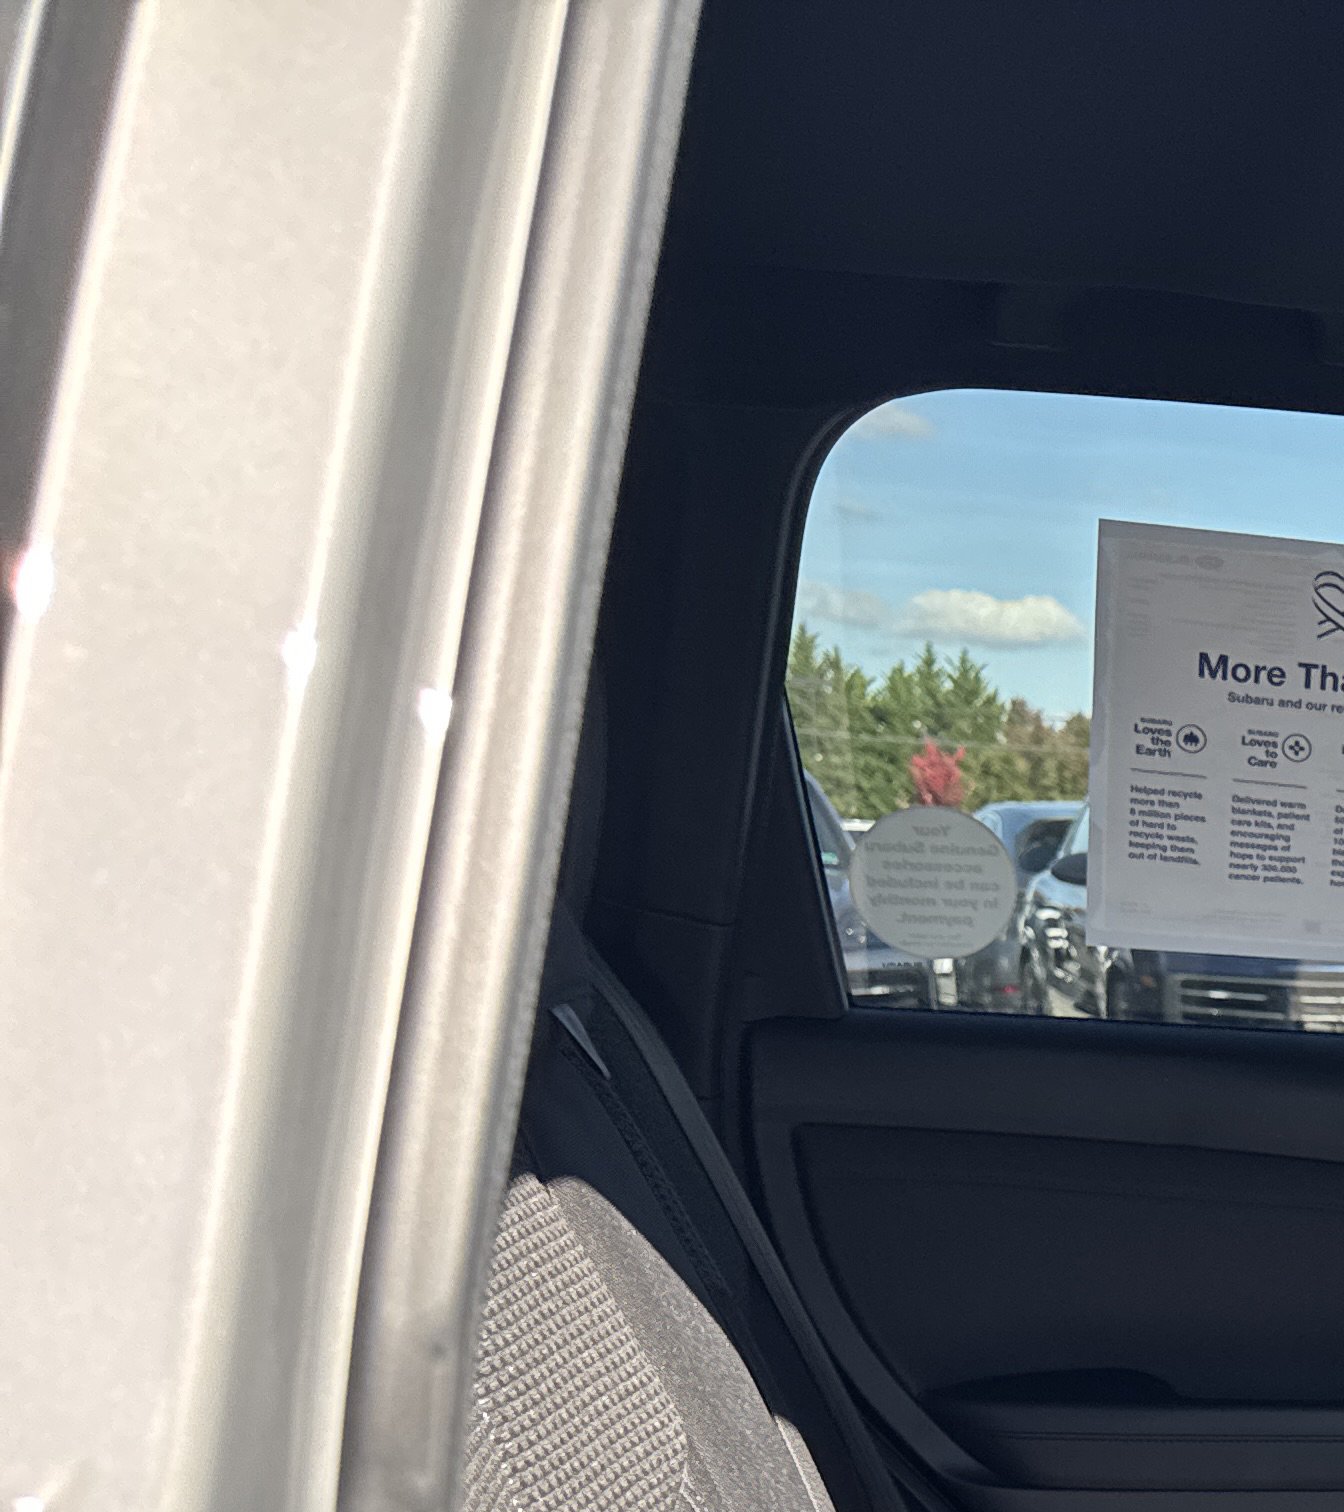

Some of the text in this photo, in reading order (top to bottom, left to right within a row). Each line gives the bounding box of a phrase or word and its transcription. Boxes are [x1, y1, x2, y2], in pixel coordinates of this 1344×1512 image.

[1199, 652, 1286, 686] More
[1228, 691, 1274, 709] Subaru
[1277, 696, 1302, 711] and
[1306, 700, 1326, 713] our
[1134, 724, 1172, 737] Loves
[1151, 736, 1172, 747] the
[1242, 736, 1278, 748] Loves
[1136, 745, 1171, 759] Earth
[1266, 750, 1278, 759] to
[1248, 756, 1277, 769] Care
[1131, 785, 1202, 801] Helped recycle
[1130, 799, 1180, 809] more than
[1232, 795, 1306, 809] Delivered warm
[1138, 809, 1171, 819] million
[1174, 811, 1206, 823] pieces
[1232, 806, 1310, 822] blankets, patient
[1129, 819, 1177, 831] of hard to
[1231, 819, 1294, 831] care kits, and
[1333, 827, 1343, 835] of
[1129, 830, 1164, 842] recycle
[1230, 830, 1290, 843] encouraging
[1129, 841, 1194, 854] keeping them
[1230, 840, 1291, 852] messages of
[1129, 852, 1144, 860] out
[1147, 852, 1157, 861] of
[1230, 851, 1305, 865] hope to support
[1229, 862, 1258, 872] nearly
[1228, 873, 1260, 881] cancer
